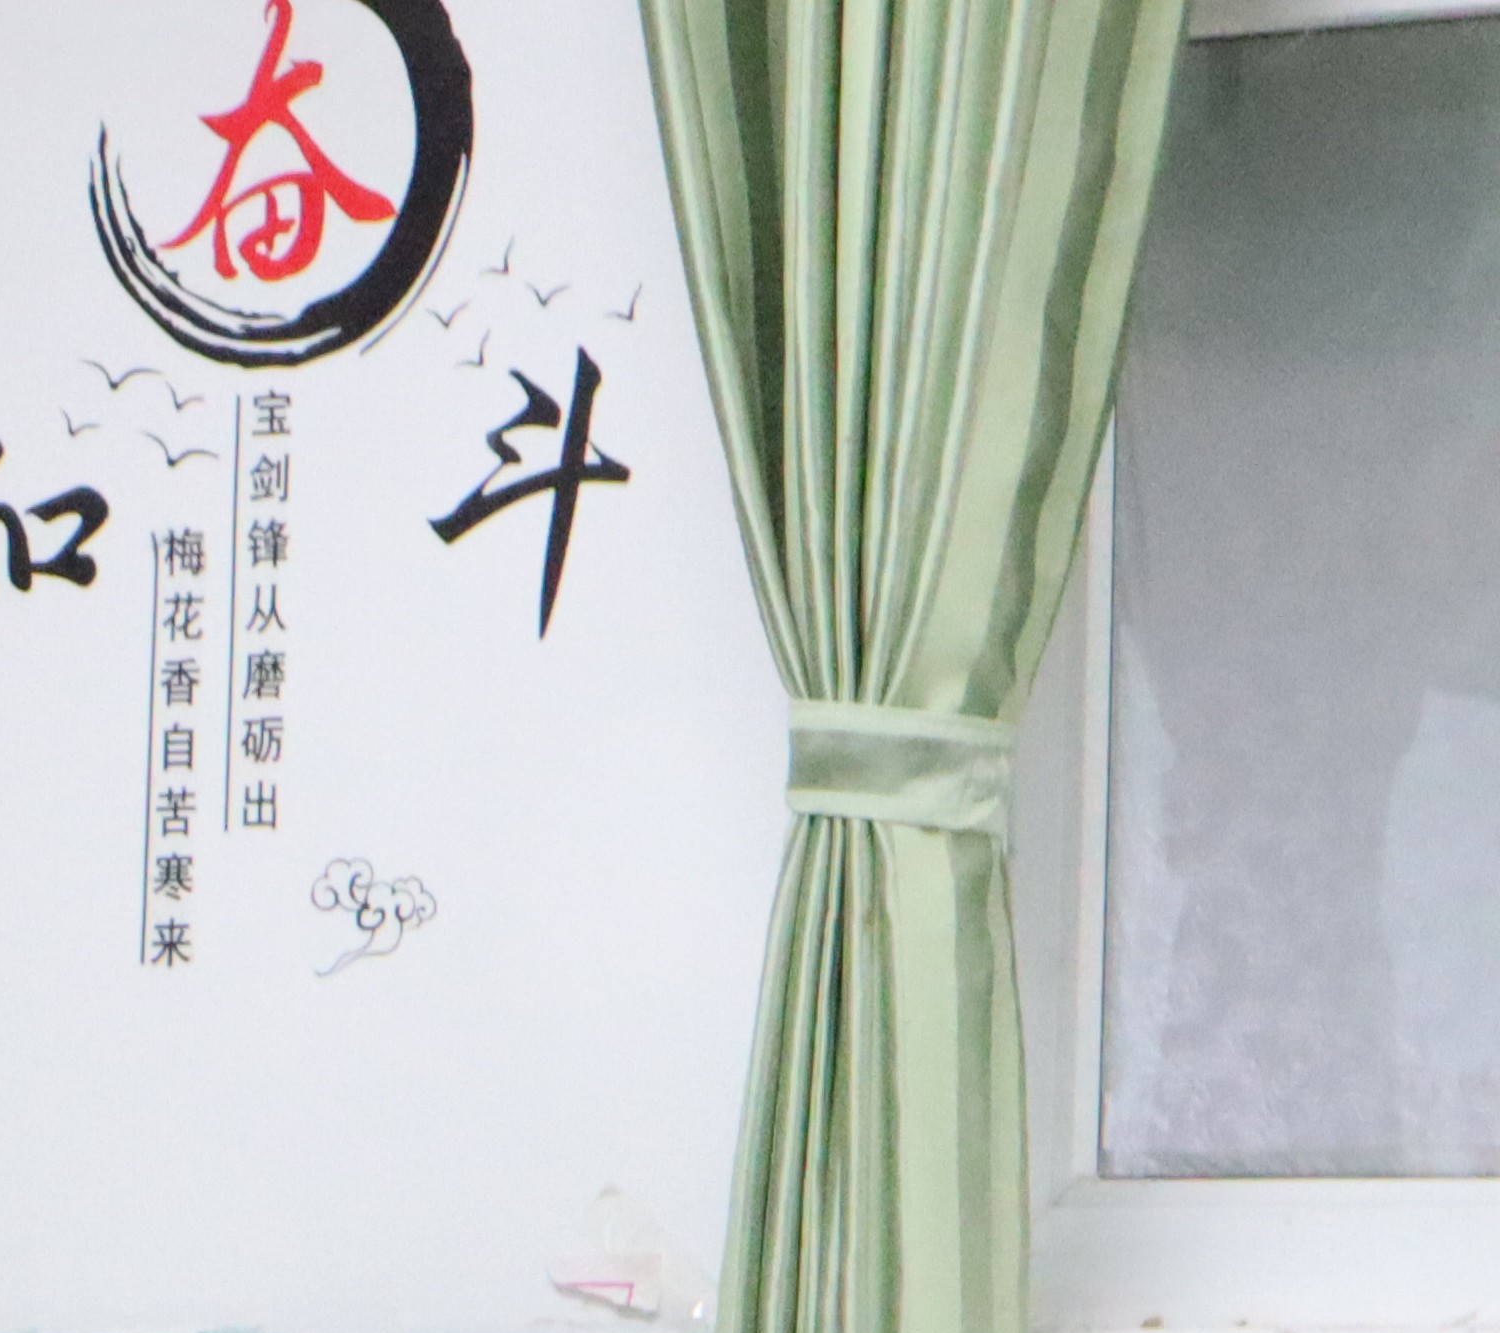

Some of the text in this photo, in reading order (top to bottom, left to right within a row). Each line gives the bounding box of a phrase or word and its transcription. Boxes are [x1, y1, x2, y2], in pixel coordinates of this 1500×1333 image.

[159, 0, 397, 282] 奋
[241, 391, 292, 830] 宝剑锋从磨砺出
[428, 346, 630, 640] 斗
[150, 528, 206, 967] 梅花香自苦寒来
